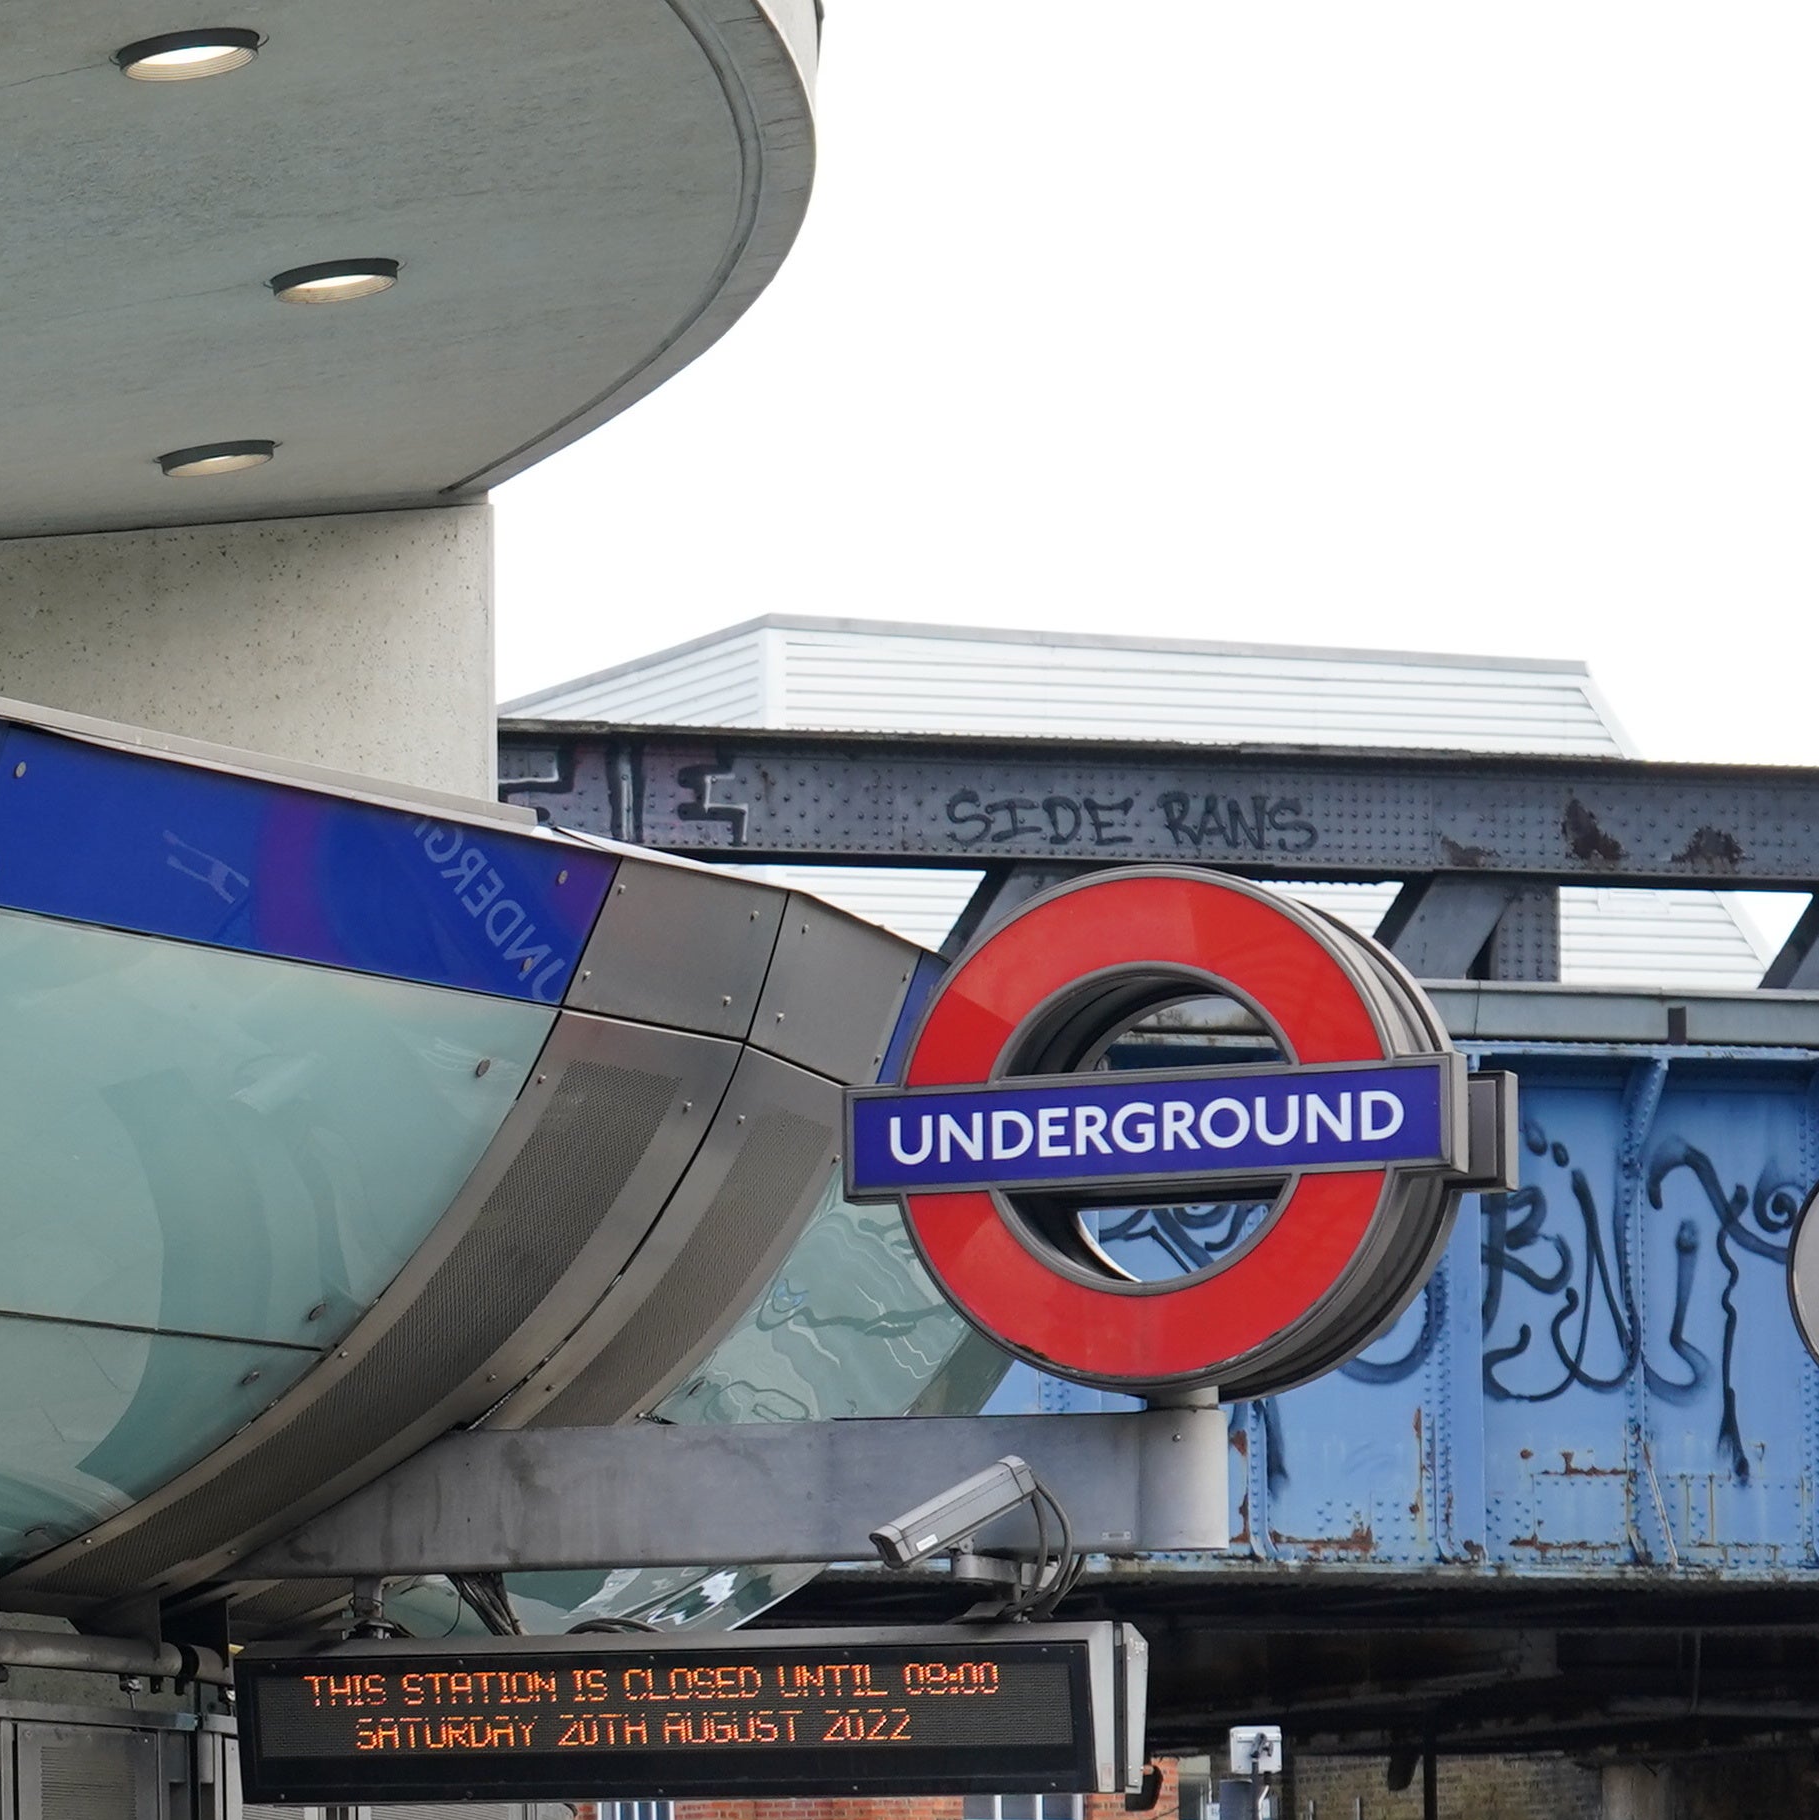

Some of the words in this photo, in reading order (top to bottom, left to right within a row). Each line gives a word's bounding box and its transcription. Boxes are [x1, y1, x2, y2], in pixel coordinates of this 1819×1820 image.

[946, 788, 1134, 846] SIDE
[889, 1090, 1405, 1165] UNDERGROUND
[304, 1673, 387, 1707] THIS
[400, 1670, 557, 1706] STATION
[572, 1668, 608, 1702] IS
[623, 1666, 762, 1701] CLOSED
[776, 1664, 889, 1698] UNTIL
[355, 1714, 539, 1750] SATURDAY
[558, 1712, 649, 1747] 20TH
[662, 1709, 803, 1744] AUGUST
[821, 1707, 912, 1742] 2022
